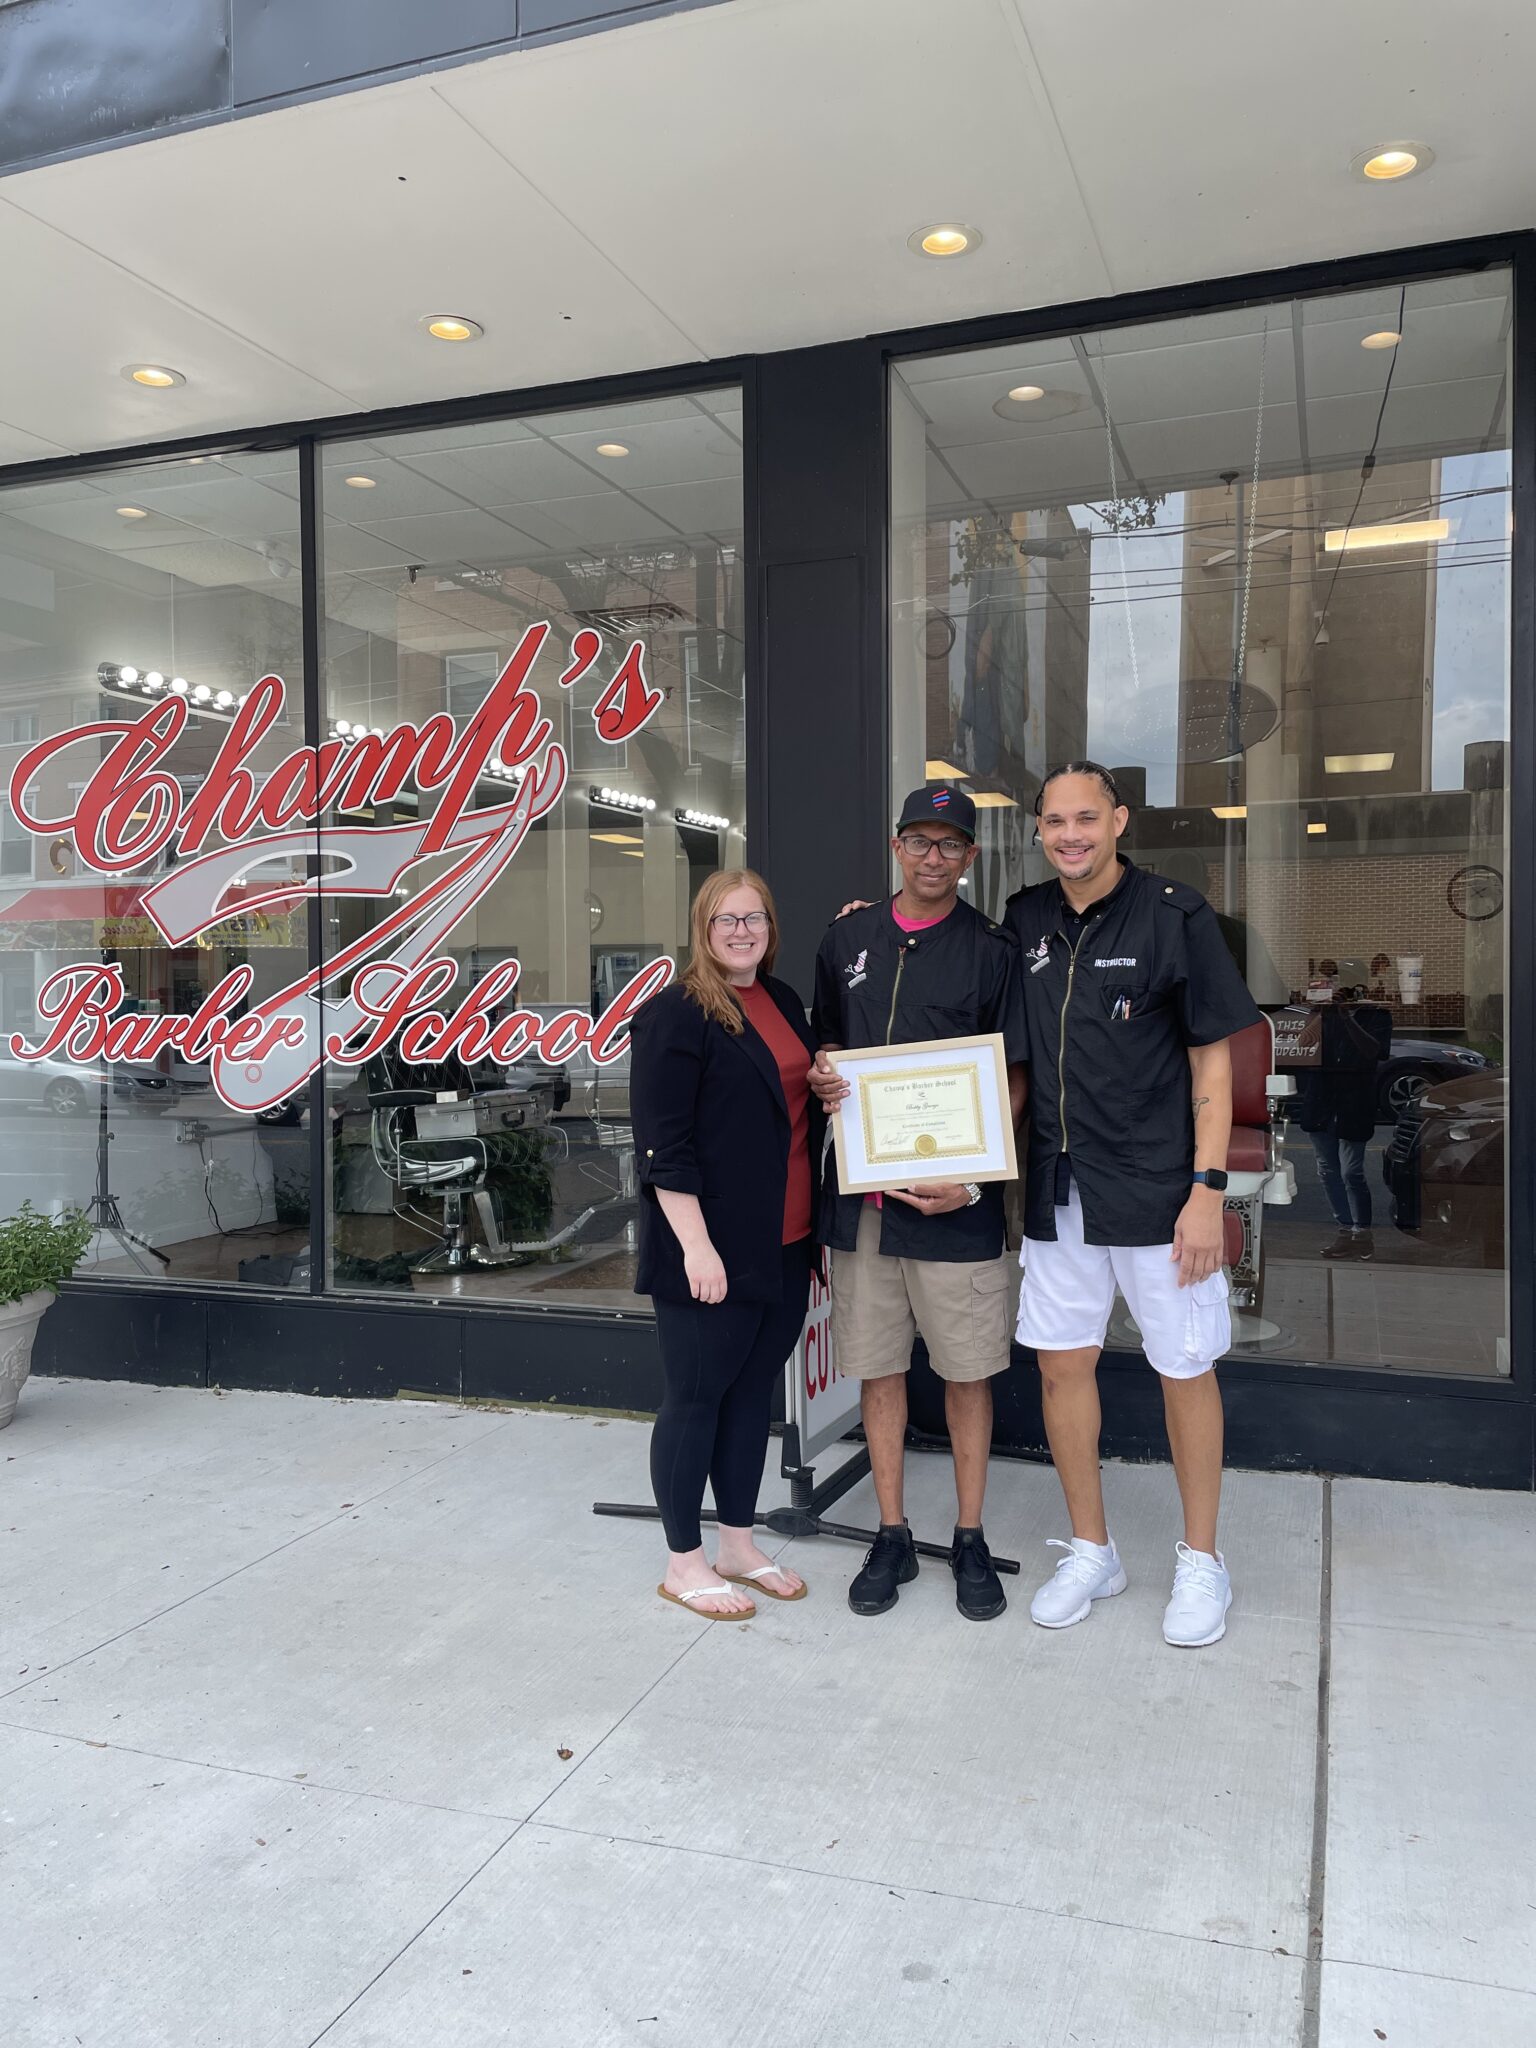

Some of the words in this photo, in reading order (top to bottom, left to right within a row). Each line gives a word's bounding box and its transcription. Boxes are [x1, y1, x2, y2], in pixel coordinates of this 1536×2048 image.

[10, 620, 663, 873] Champ's
[1094, 957, 1136, 968] INSTRUCTOR
[9, 962, 307, 1064] Barber
[326, 956, 674, 1066] School
[1277, 1020, 1306, 1031] THIS
[1287, 1033, 1301, 1043] BY
